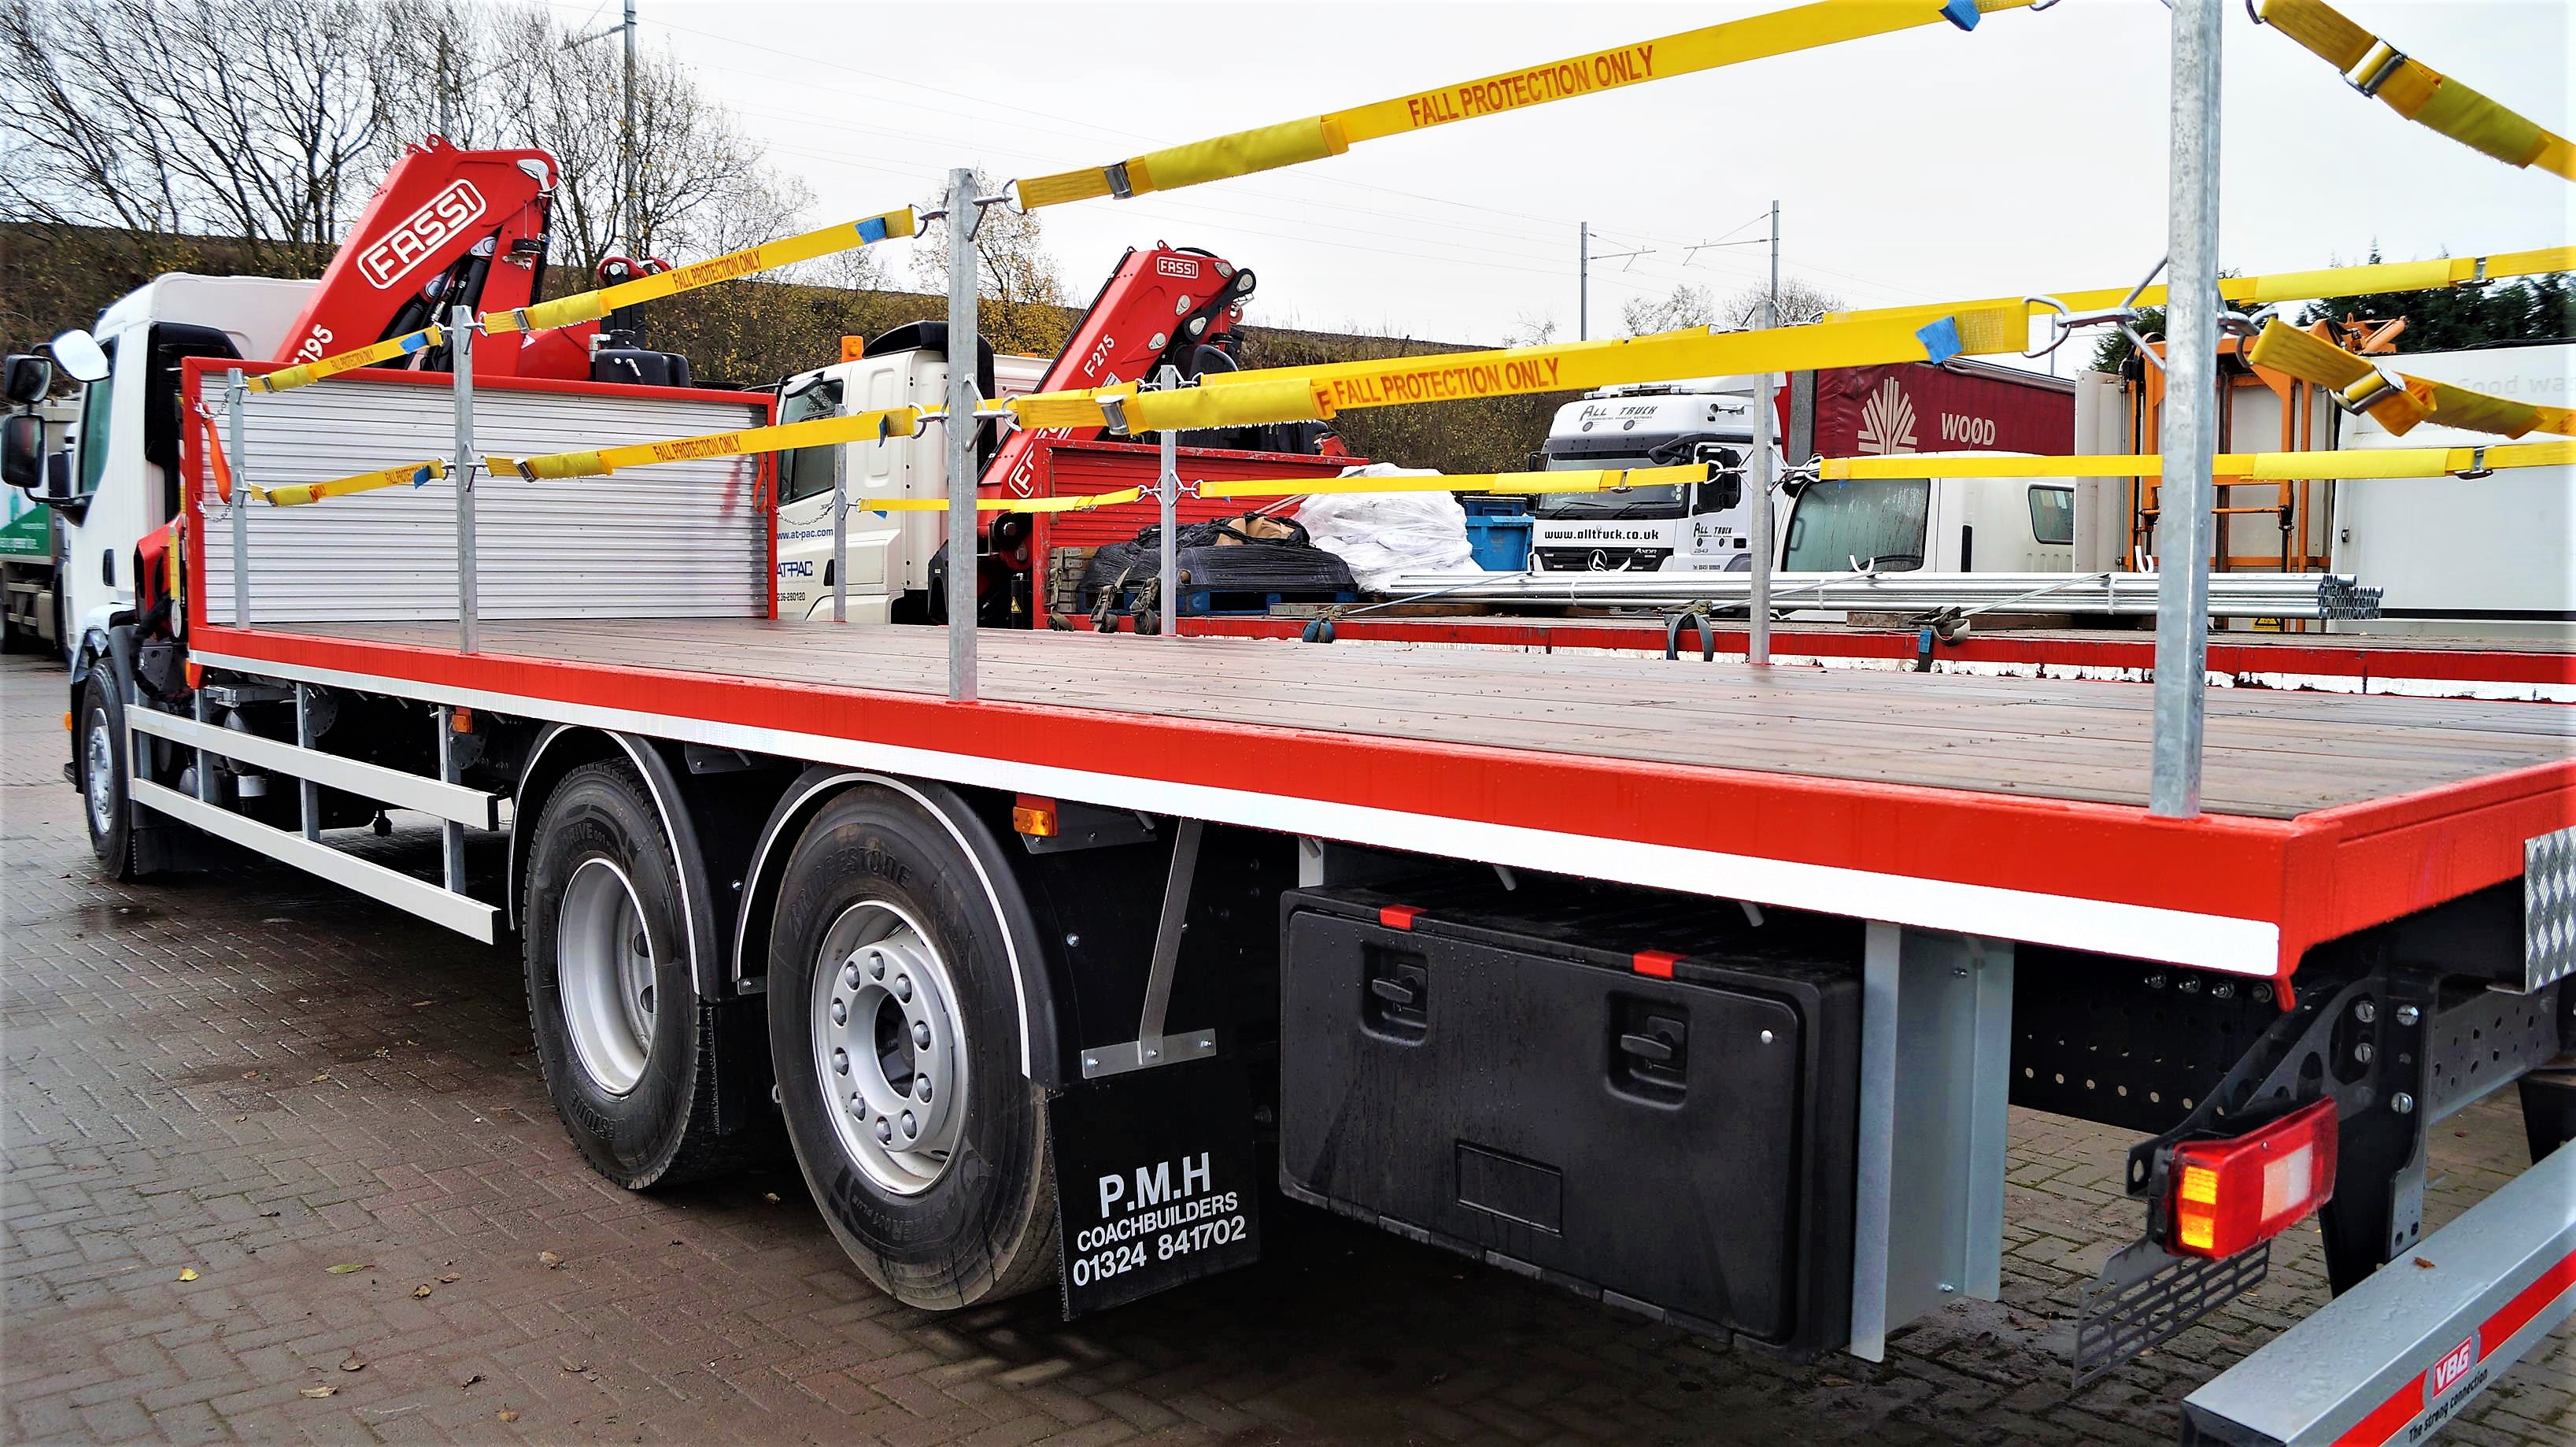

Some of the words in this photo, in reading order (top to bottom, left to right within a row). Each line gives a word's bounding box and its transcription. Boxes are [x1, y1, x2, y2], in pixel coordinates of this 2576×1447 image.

[1406, 92, 1460, 128] FALL
[1458, 60, 1591, 117] PROTECTION
[1594, 44, 1654, 87] ONLY
[367, 187, 478, 281] FASSI
[671, 270, 693, 291] FALL
[692, 257, 741, 286] PROTECTION
[738, 250, 762, 273] ONLY
[1160, 260, 1196, 276] FASSI
[1083, 333, 1115, 378] F275
[1333, 377, 1381, 405] FALL
[1380, 364, 1503, 402] PROTECTION
[1505, 357, 1560, 390] ONLY
[1619, 405, 1658, 416] TRUCK
[1941, 412, 1996, 446] WOOD
[652, 444, 675, 461] FALL
[671, 437, 722, 460] PROTECTION
[719, 434, 742, 454] ONLY
[1544, 529, 1659, 540] www.alltruck.co.uk
[1099, 1152, 1210, 1219] P.M.H
[1077, 1191, 1238, 1252] COACHBUILDERS
[1073, 1242, 1148, 1286] 01324
[1158, 1215, 1247, 1260] 841702
[2436, 1343, 2470, 1390] VBG
[2409, 1424, 2423, 1443] The
[2424, 1402, 2448, 1432] strong
[2450, 1368, 2488, 1409] connection
